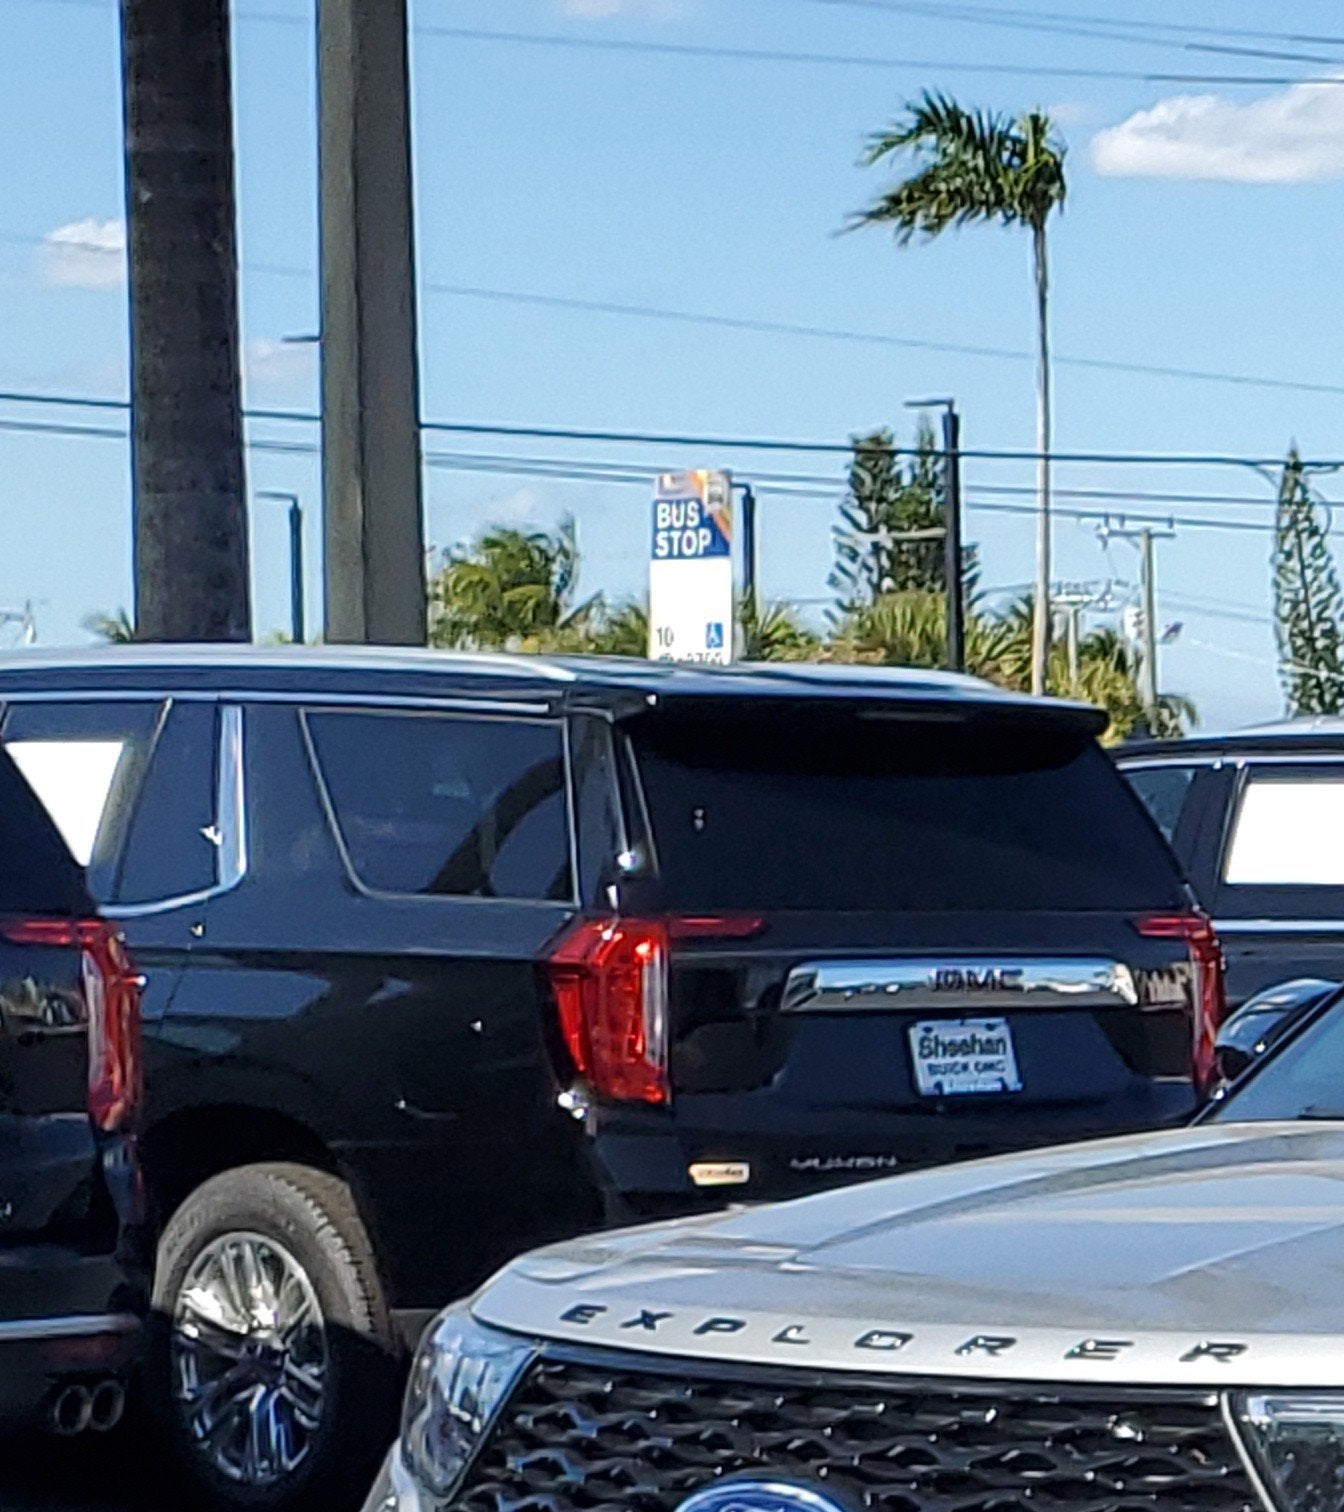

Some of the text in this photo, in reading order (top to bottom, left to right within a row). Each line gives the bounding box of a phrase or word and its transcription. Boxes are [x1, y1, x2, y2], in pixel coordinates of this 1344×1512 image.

[657, 501, 700, 528] BUS
[655, 528, 712, 557] STOP
[656, 626, 675, 648] 10
[932, 968, 1024, 992] GMC
[918, 1033, 1007, 1060] Sheehan
[558, 1303, 1250, 1364] EXPLORER
